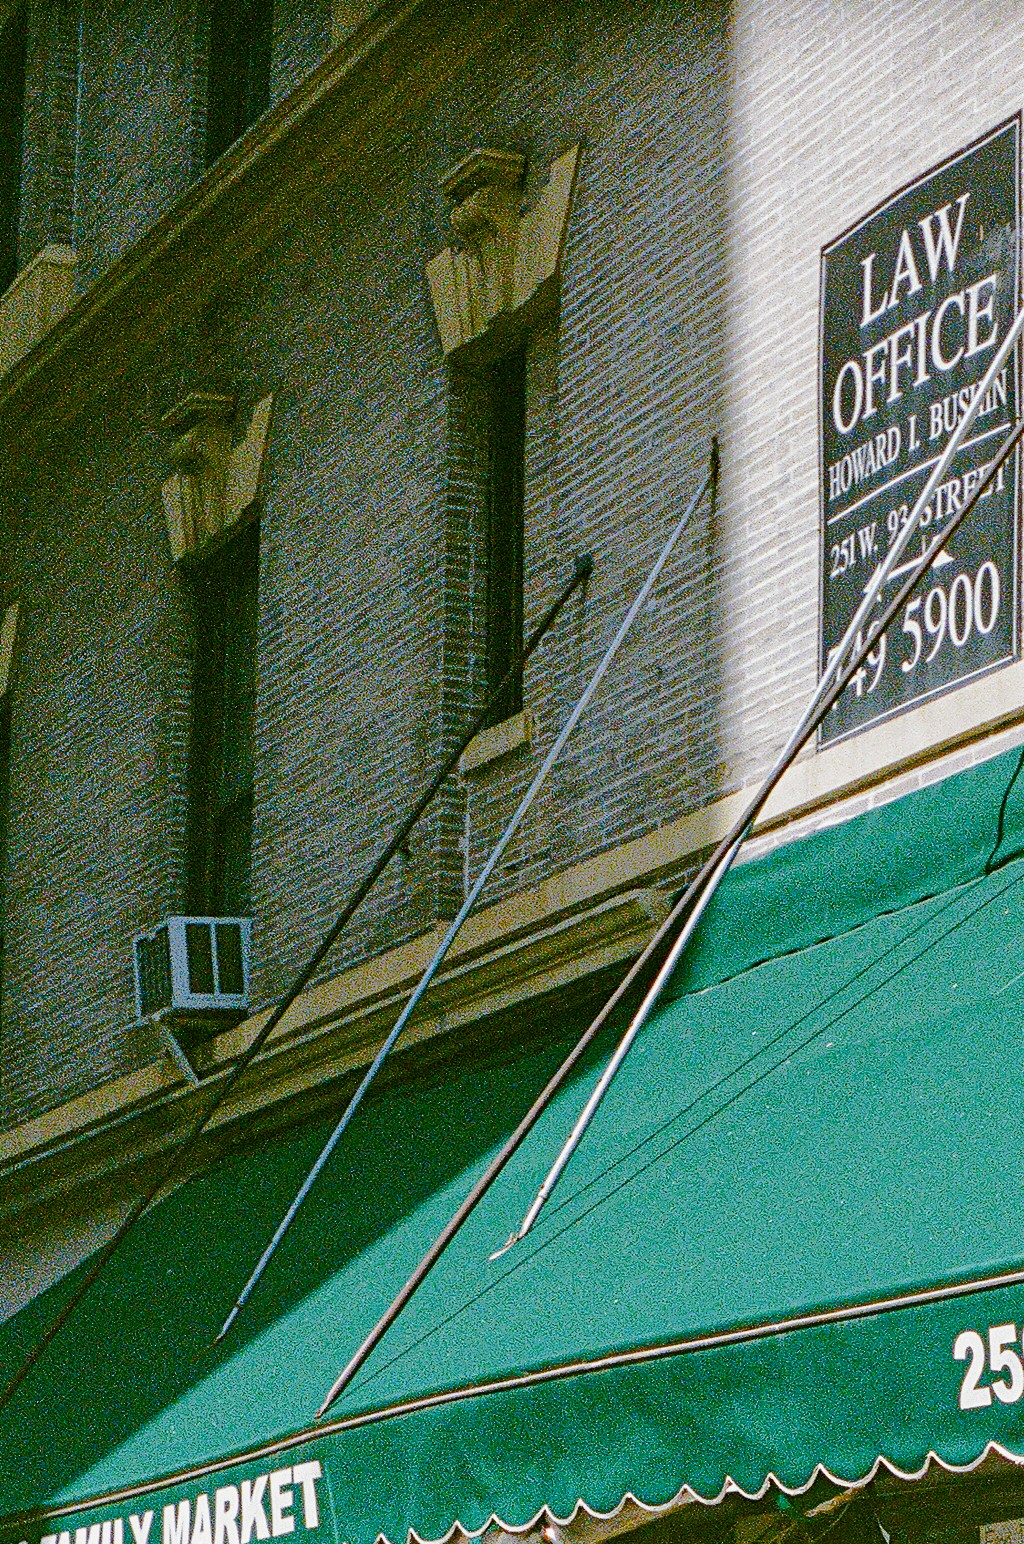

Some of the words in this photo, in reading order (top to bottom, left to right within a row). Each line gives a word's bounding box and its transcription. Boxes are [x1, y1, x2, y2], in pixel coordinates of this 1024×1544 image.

[860, 193, 970, 327] LAW
[834, 273, 998, 435] OFFICE
[828, 415, 901, 501] HOWARD
[908, 410, 921, 452] I.
[830, 541, 857, 579] 251
[858, 522, 878, 560] W.
[901, 561, 1000, 673] 5900
